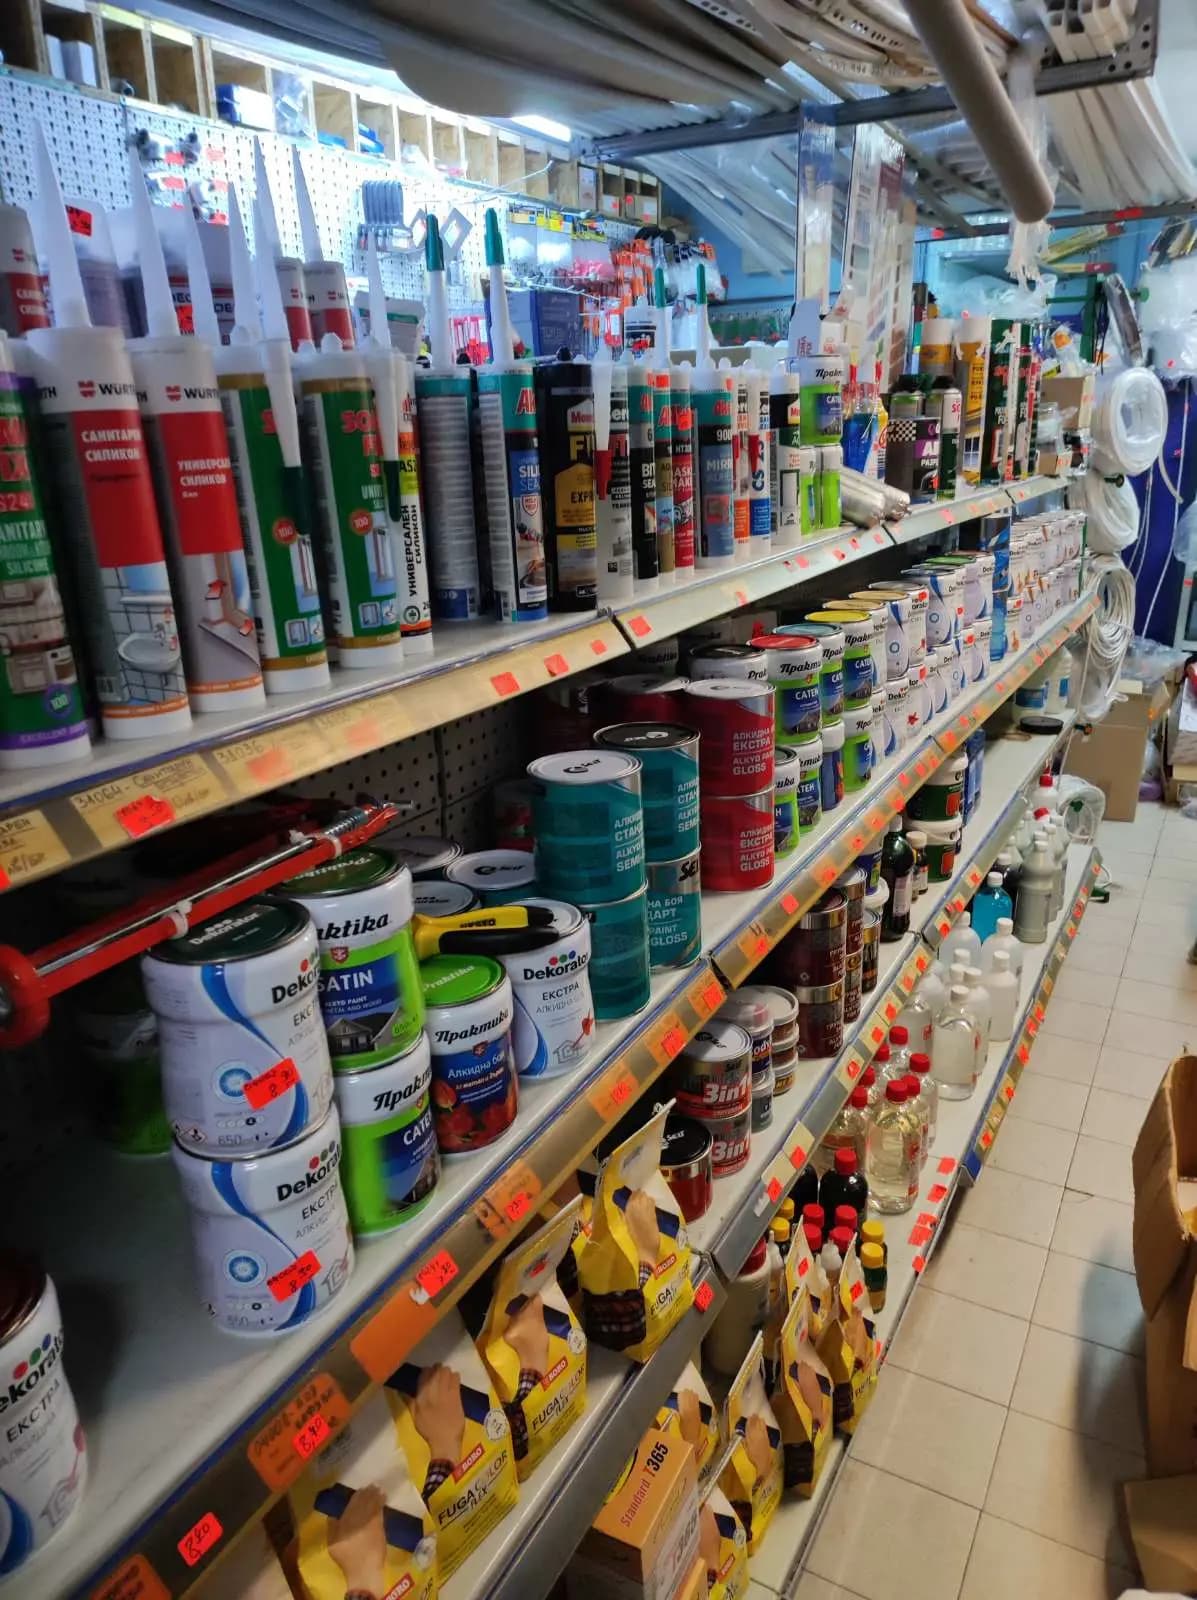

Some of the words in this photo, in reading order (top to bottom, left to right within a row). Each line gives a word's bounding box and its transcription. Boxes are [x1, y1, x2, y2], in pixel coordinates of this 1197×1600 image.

[410, 503, 423, 565] СИЛИКОН
[401, 504, 418, 597] УНИВЕРСАЛЕН
[733, 738, 771, 751] ЕКСТРА
[733, 754, 761, 765] ALKYD
[733, 763, 767, 775] GLOSS
[740, 859, 770, 872] GLOSS
[664, 896, 683, 908] БОЯ
[650, 932, 688, 947] GLOSS
[317, 970, 374, 992] SATIN
[542, 982, 580, 1002] ЕКСТРА
[448, 1061, 491, 1079] Алкидна
[532, 1396, 560, 1429] FUGA
[620, 1477, 650, 1528] Standard
[648, 1440, 669, 1478] T365
[437, 1488, 476, 1525] FUGA
